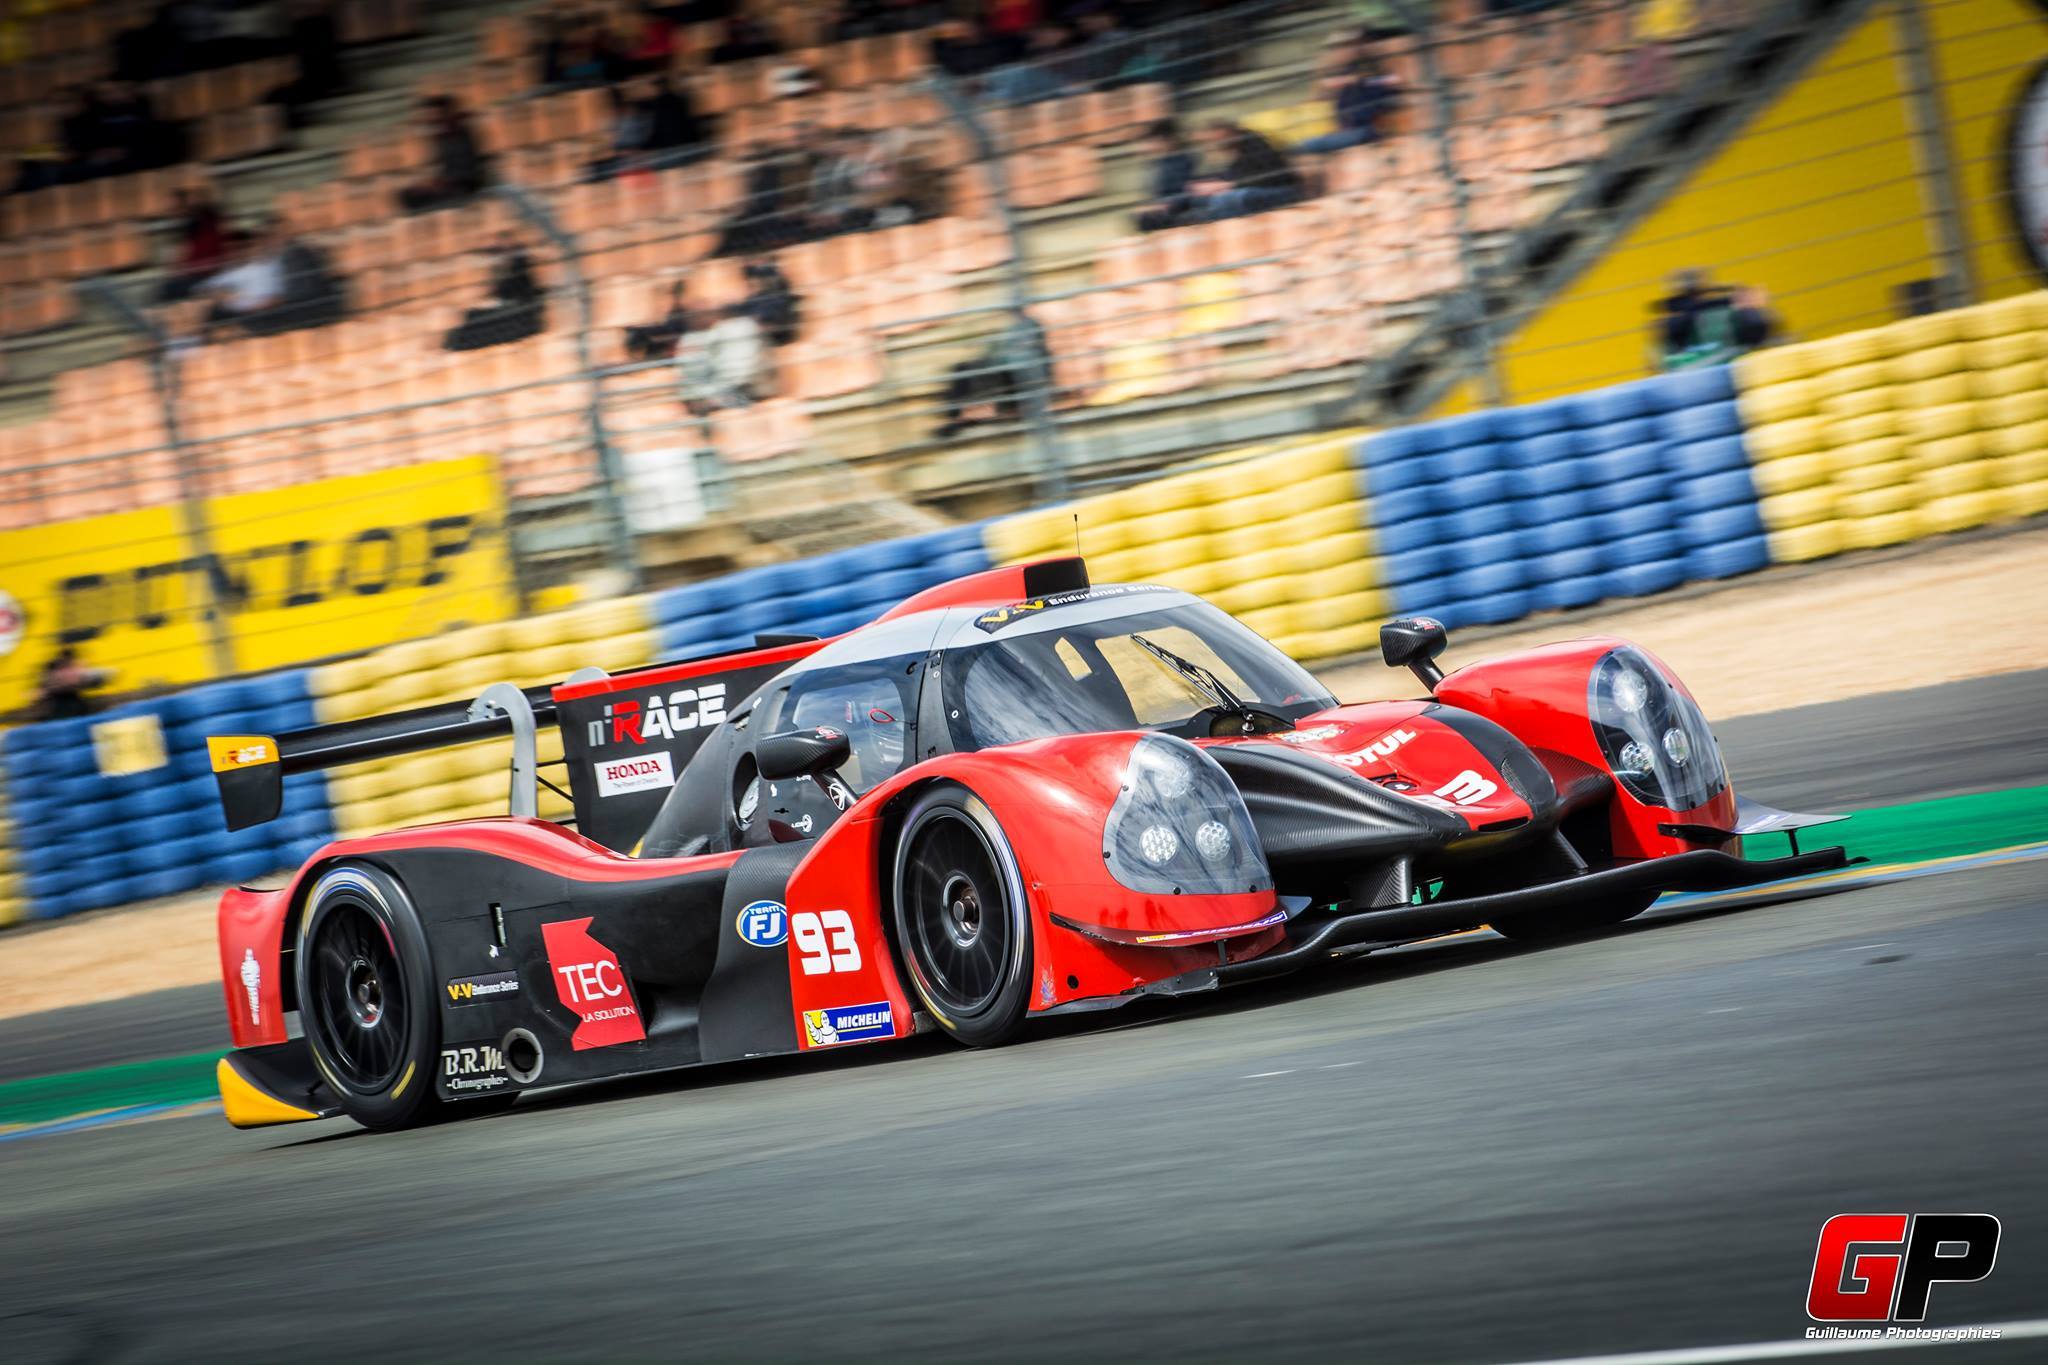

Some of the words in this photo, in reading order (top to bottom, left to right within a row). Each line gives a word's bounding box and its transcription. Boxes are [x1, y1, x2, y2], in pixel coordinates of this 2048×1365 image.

[1048, 586, 1125, 606] Endurance
[606, 760, 662, 781] HONDA
[750, 912, 781, 940] FJ
[791, 909, 862, 975] 93
[557, 960, 623, 1003] TEC
[582, 1013, 595, 1023] LA
[595, 1006, 635, 1021] SOLUTION
[837, 1010, 891, 1029] MICHELIN
